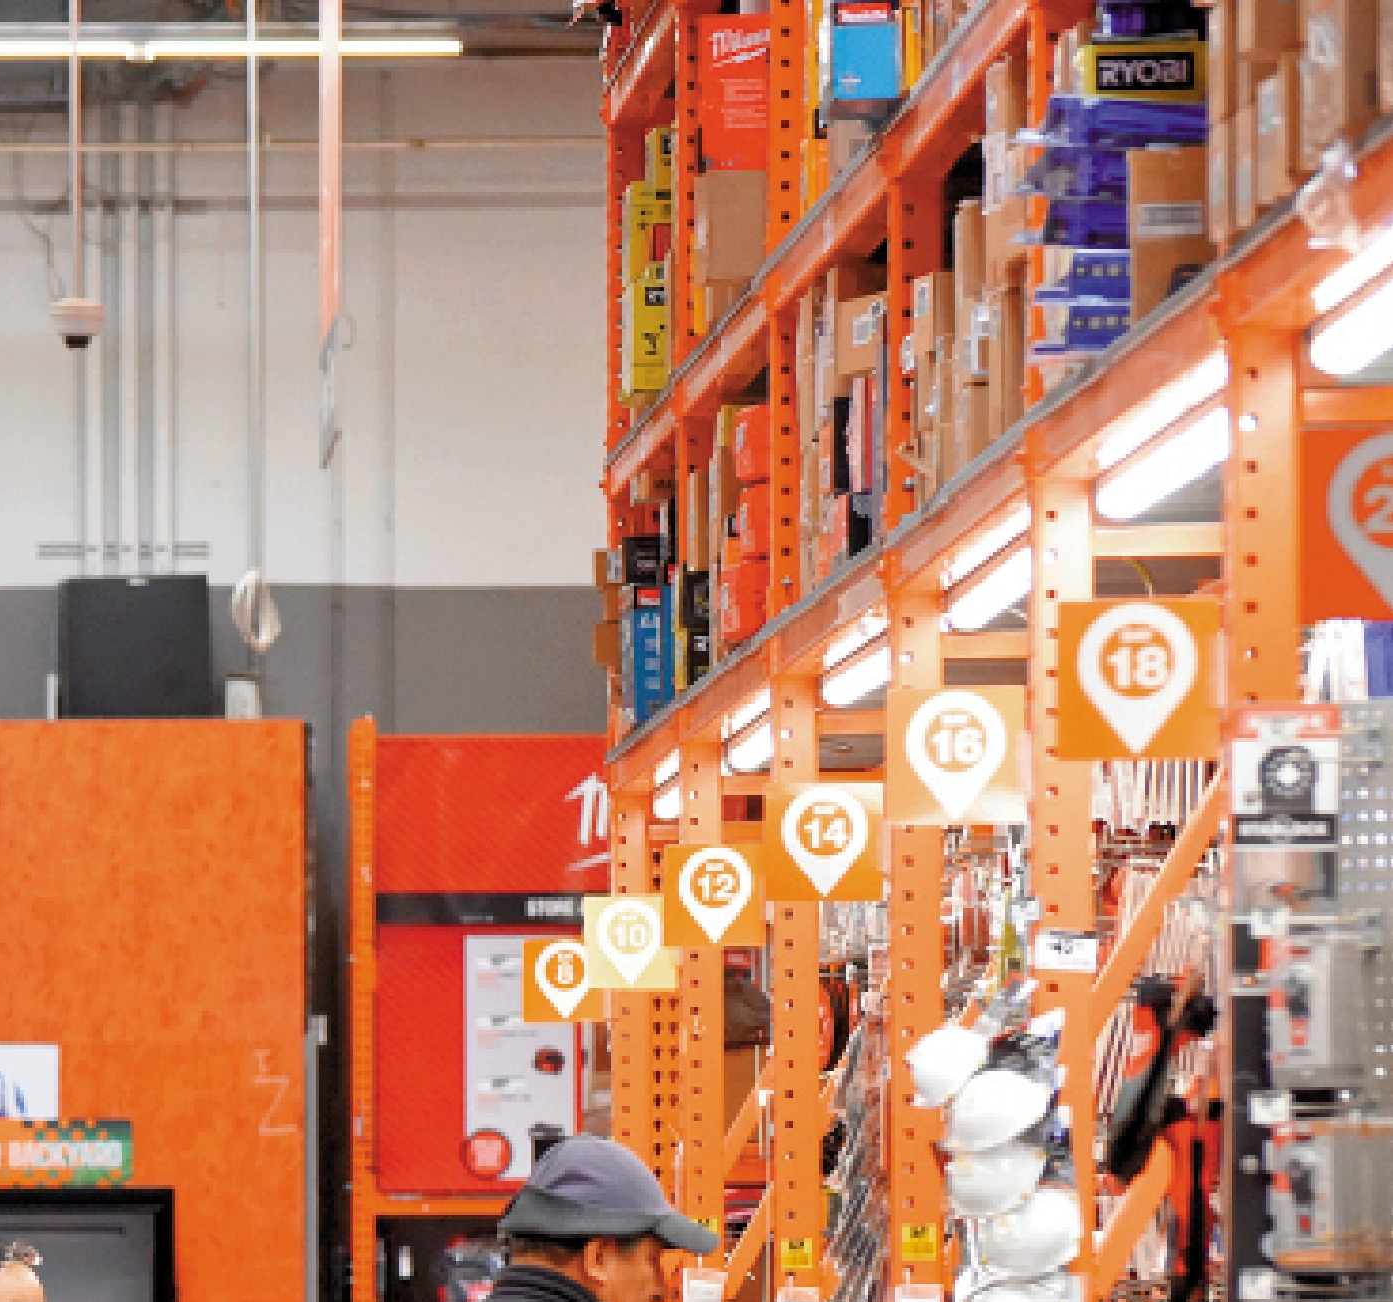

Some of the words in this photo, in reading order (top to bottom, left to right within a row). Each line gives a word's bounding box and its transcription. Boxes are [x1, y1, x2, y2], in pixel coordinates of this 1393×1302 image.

[1098, 60, 1186, 86] RYOBI
[1362, 484, 1393, 534] 2
[1106, 646, 1168, 690] 18
[933, 729, 984, 764] 16
[803, 818, 848, 850] 14
[696, 872, 737, 901] 12
[614, 923, 647, 948] 10
